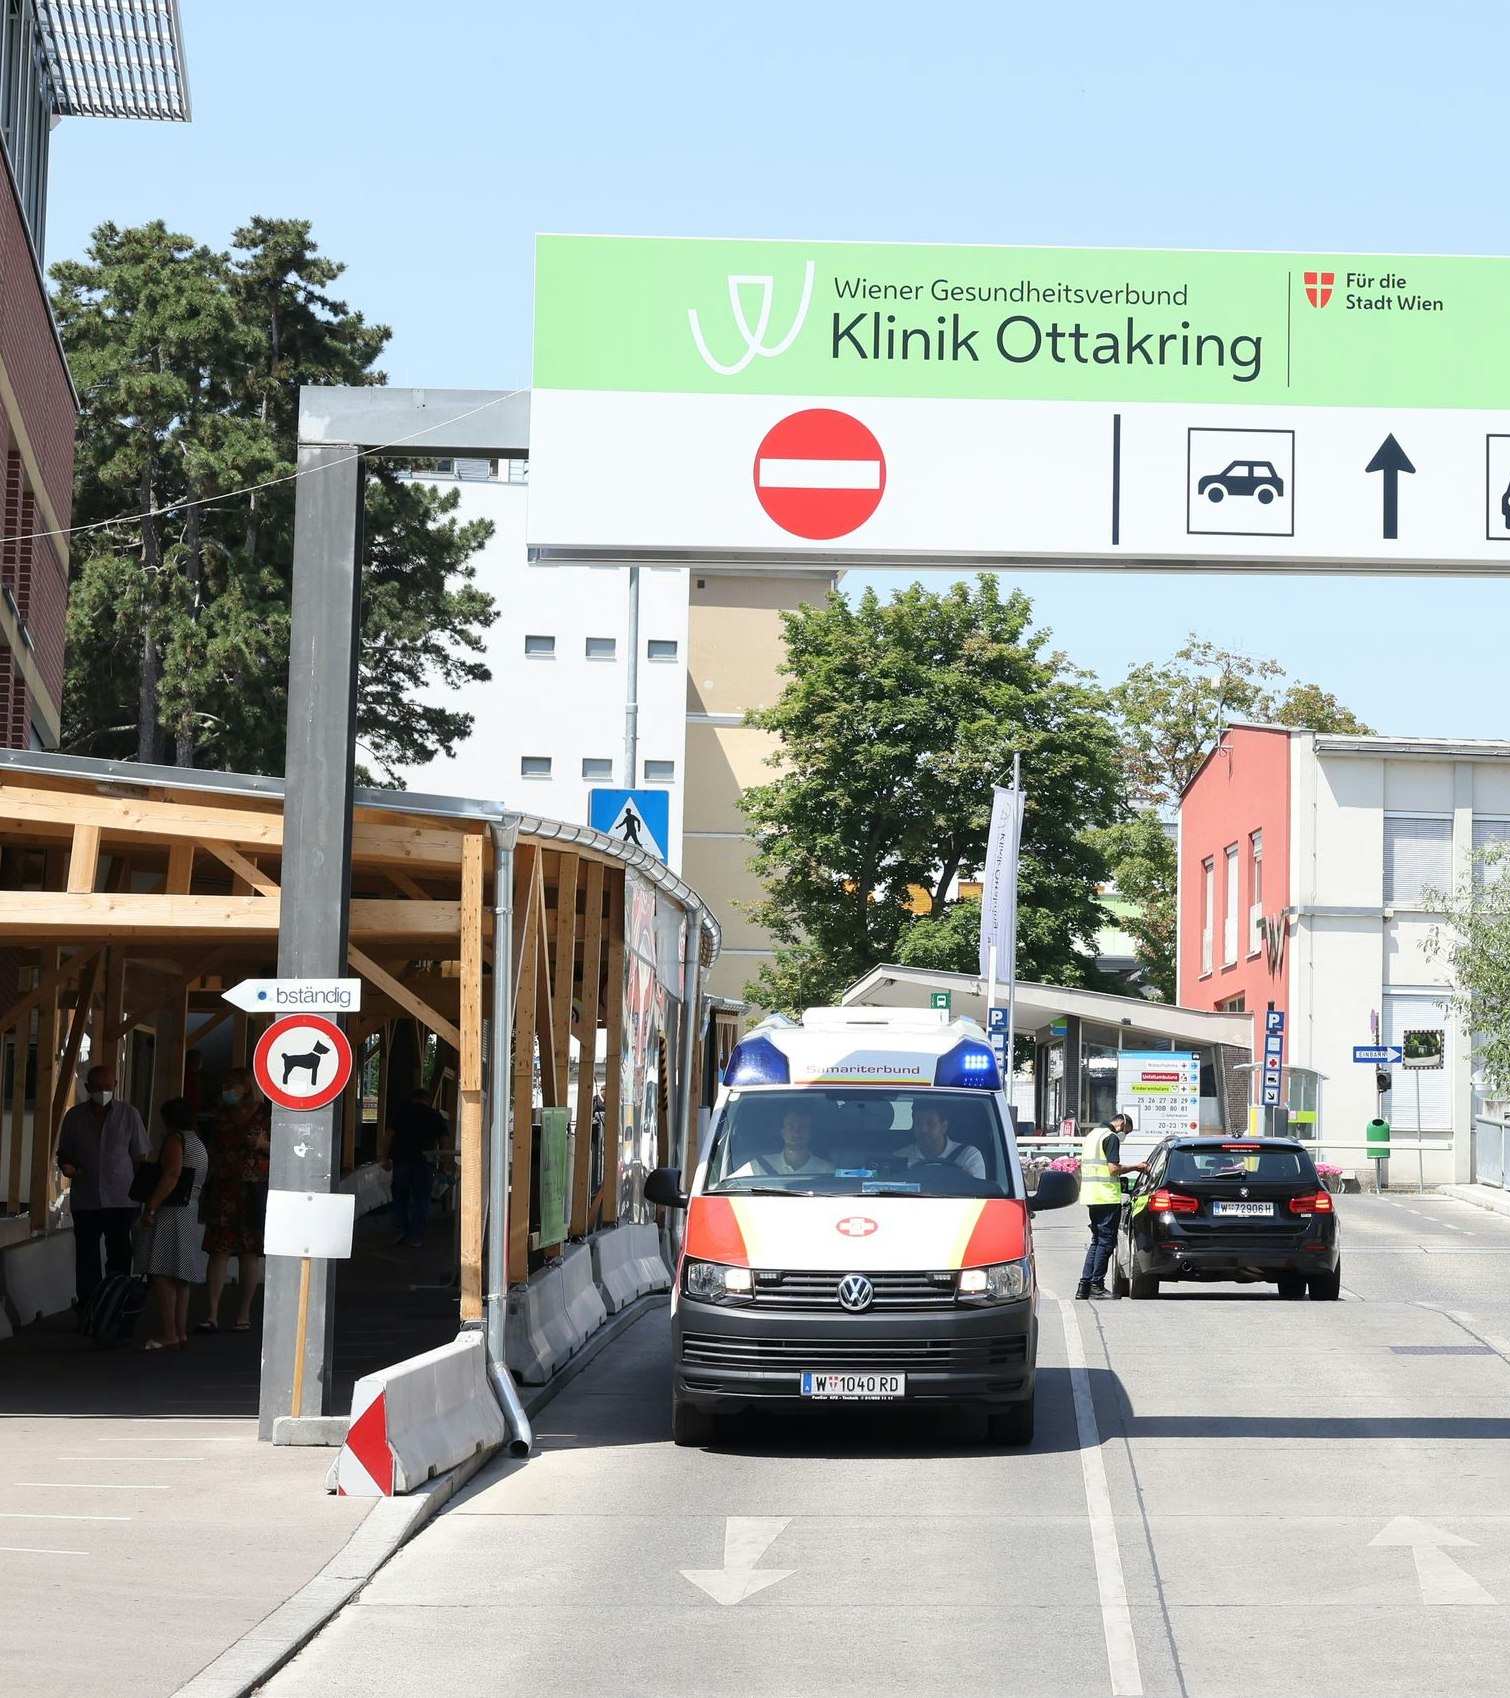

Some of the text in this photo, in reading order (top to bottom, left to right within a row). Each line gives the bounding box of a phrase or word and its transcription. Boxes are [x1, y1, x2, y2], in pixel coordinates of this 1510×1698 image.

[1346, 272, 1407, 290] Für die
[834, 276, 1188, 306] Wiener Gesundheitsverbund
[1345, 294, 1444, 312] Stadt Wien
[832, 311, 1263, 383] Klinik Ottakring
[276, 986, 351, 1009] bständig
[991, 1010, 1003, 1025] P
[1268, 1013, 1280, 1028] P
[806, 1064, 920, 1075] Samariterbund
[816, 1377, 898, 1392] W 1040 RD
